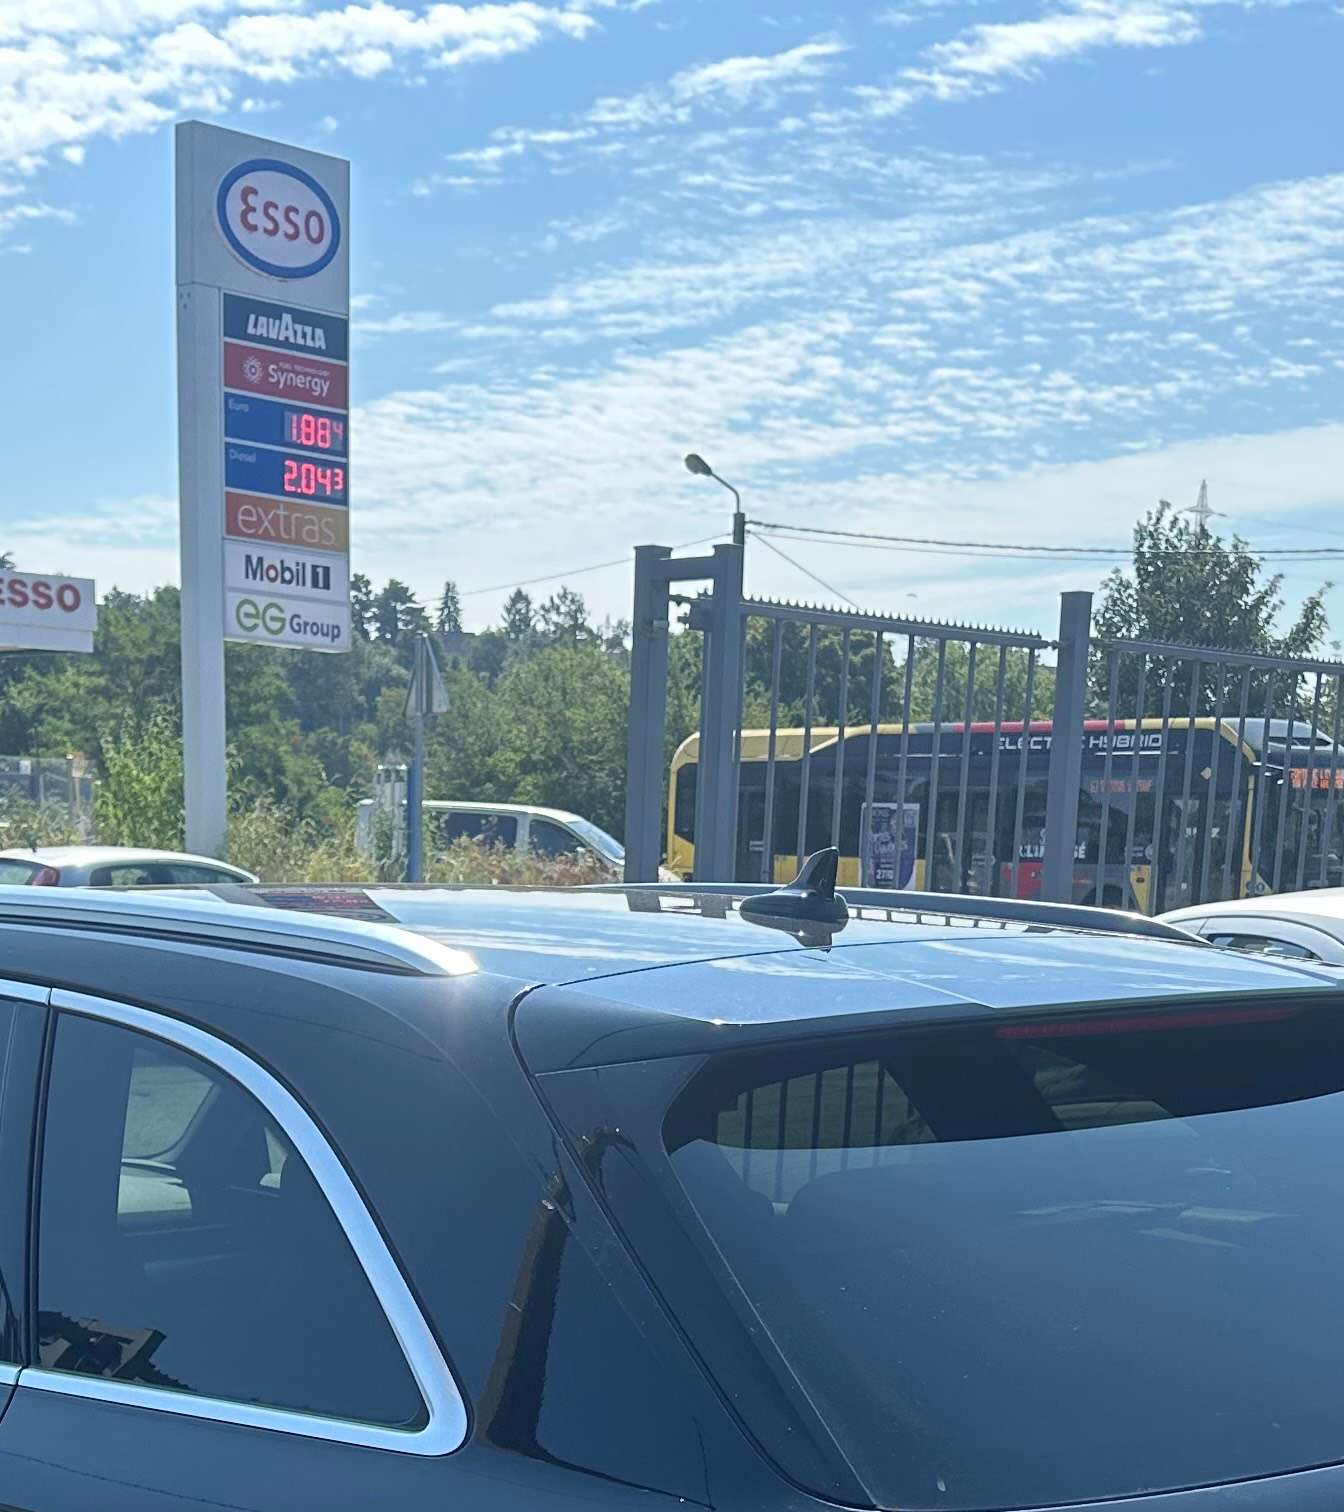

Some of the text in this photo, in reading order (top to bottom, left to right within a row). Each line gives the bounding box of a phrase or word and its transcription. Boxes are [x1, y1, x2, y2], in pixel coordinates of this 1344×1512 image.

[246, 312, 326, 349] LAVAZZA
[268, 364, 331, 397] Synergy
[237, 503, 336, 546] extras
[244, 554, 306, 587] Mobil
[289, 613, 341, 643] Group
